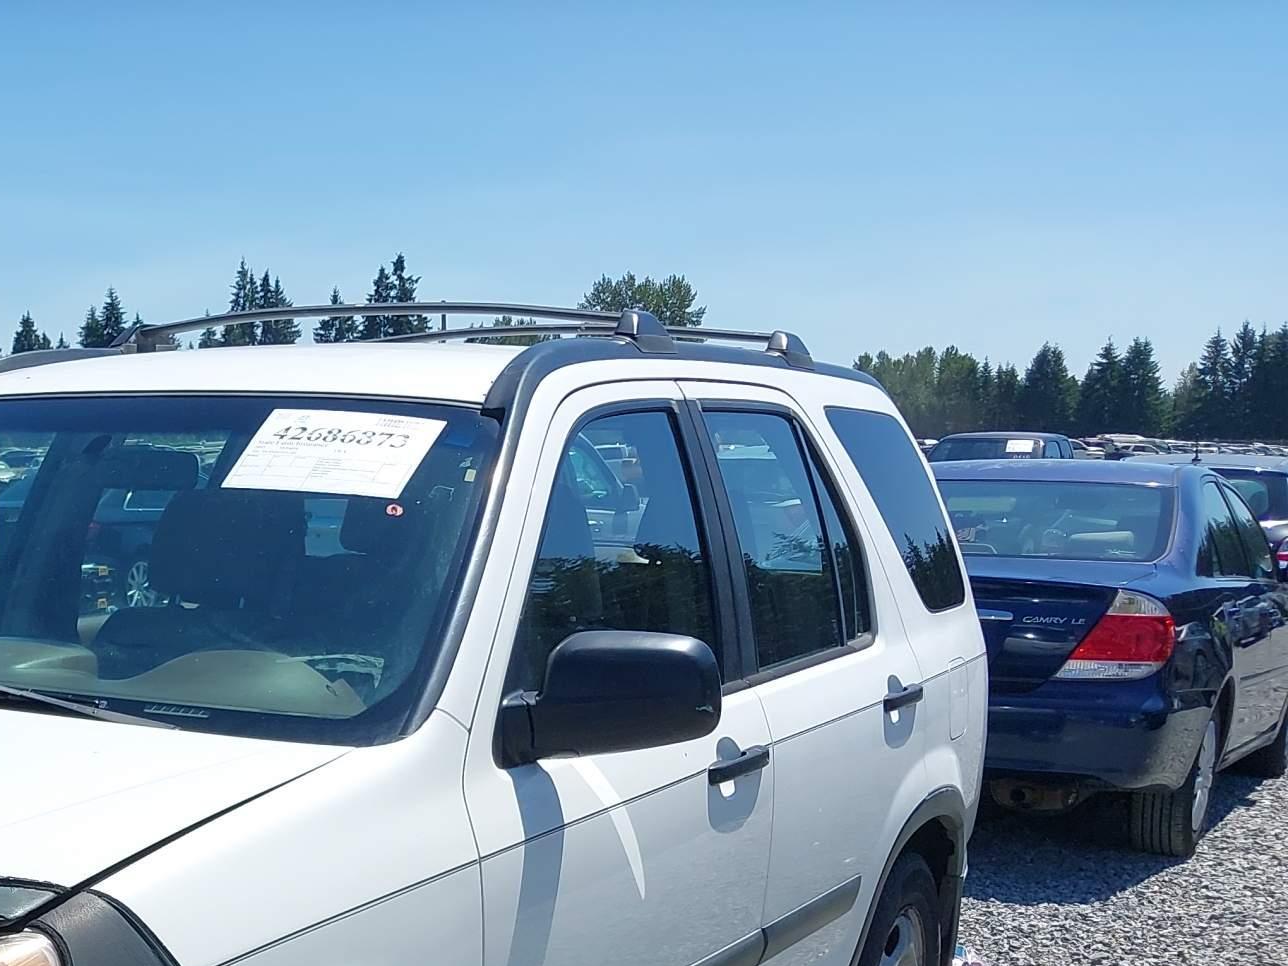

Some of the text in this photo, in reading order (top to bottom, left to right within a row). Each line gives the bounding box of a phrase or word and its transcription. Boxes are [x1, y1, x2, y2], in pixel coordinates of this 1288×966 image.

[273, 425, 410, 449] 42686873
[1022, 616, 1085, 625] CAMRY LE
